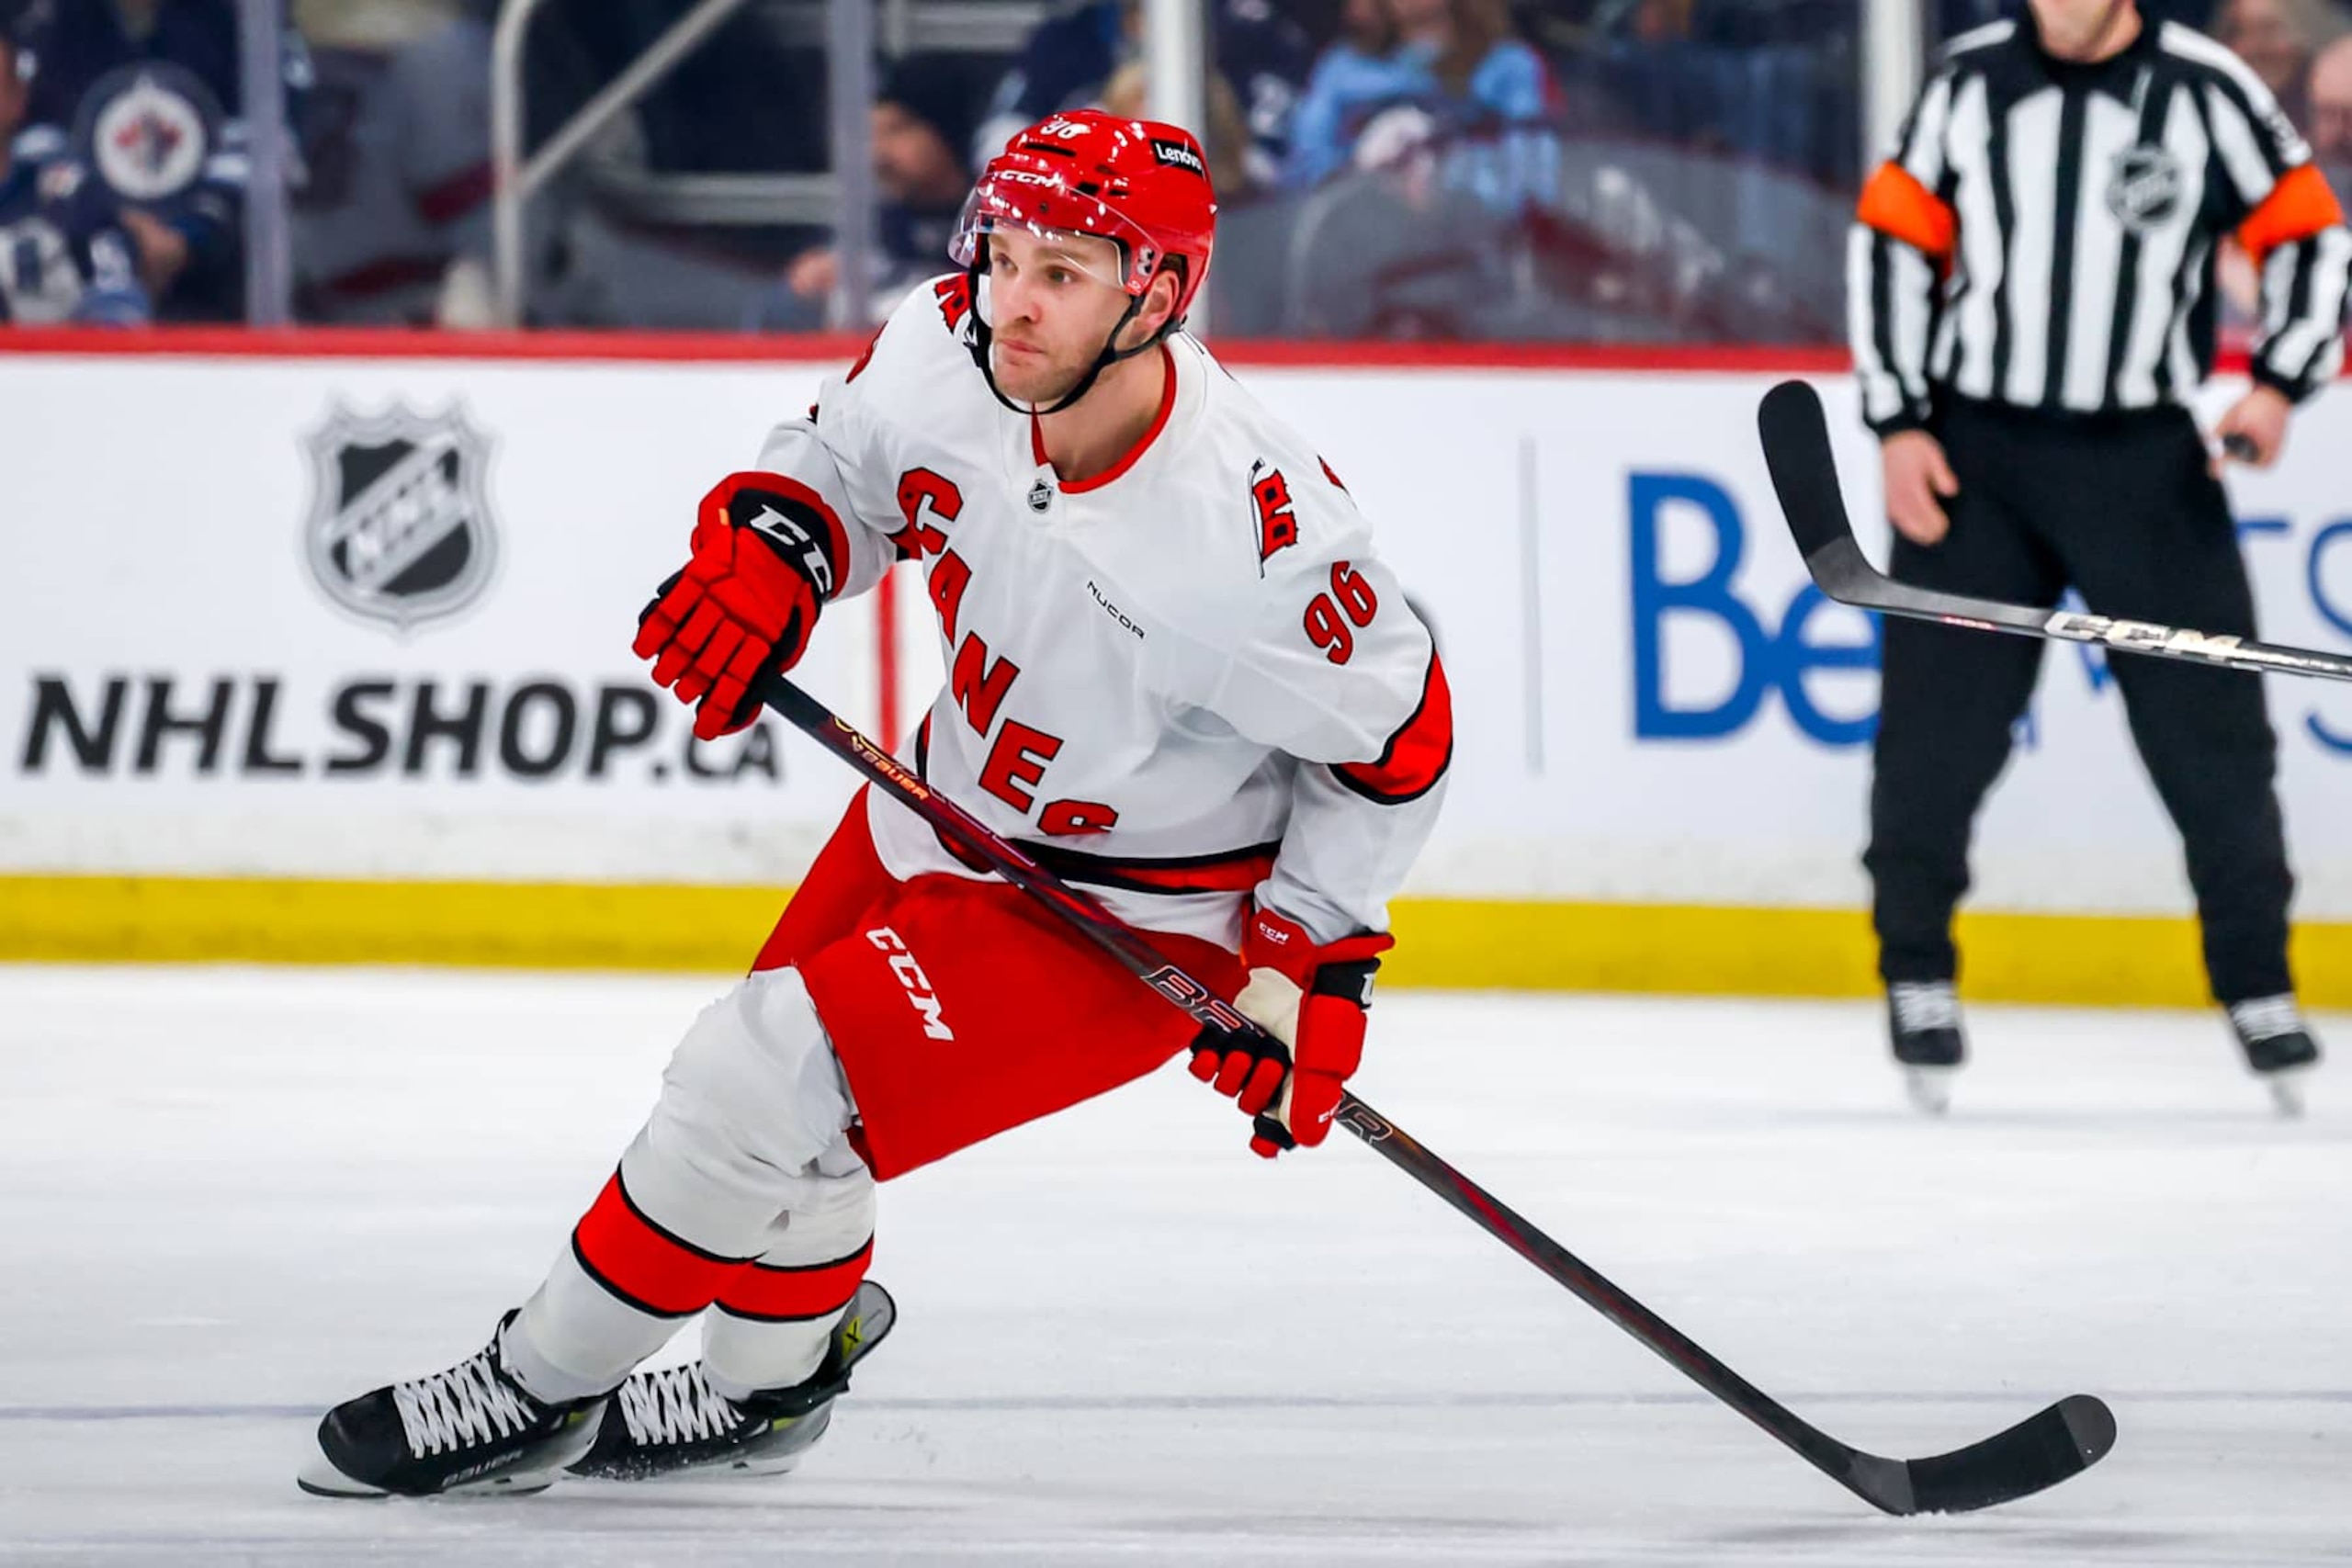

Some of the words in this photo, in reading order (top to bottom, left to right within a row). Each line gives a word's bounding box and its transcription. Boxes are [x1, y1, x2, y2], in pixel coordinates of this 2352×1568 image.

[1000, 169, 1064, 188] CCM
[1155, 142, 1202, 171] Lenovo
[749, 503, 832, 594] CC
[1087, 581, 1145, 639] NUCOR
[1303, 560, 1379, 666] 96
[20, 675, 781, 782] NHLSHOP.CA
[1259, 921, 1290, 942] CCM
[865, 926, 955, 1041] CCM
